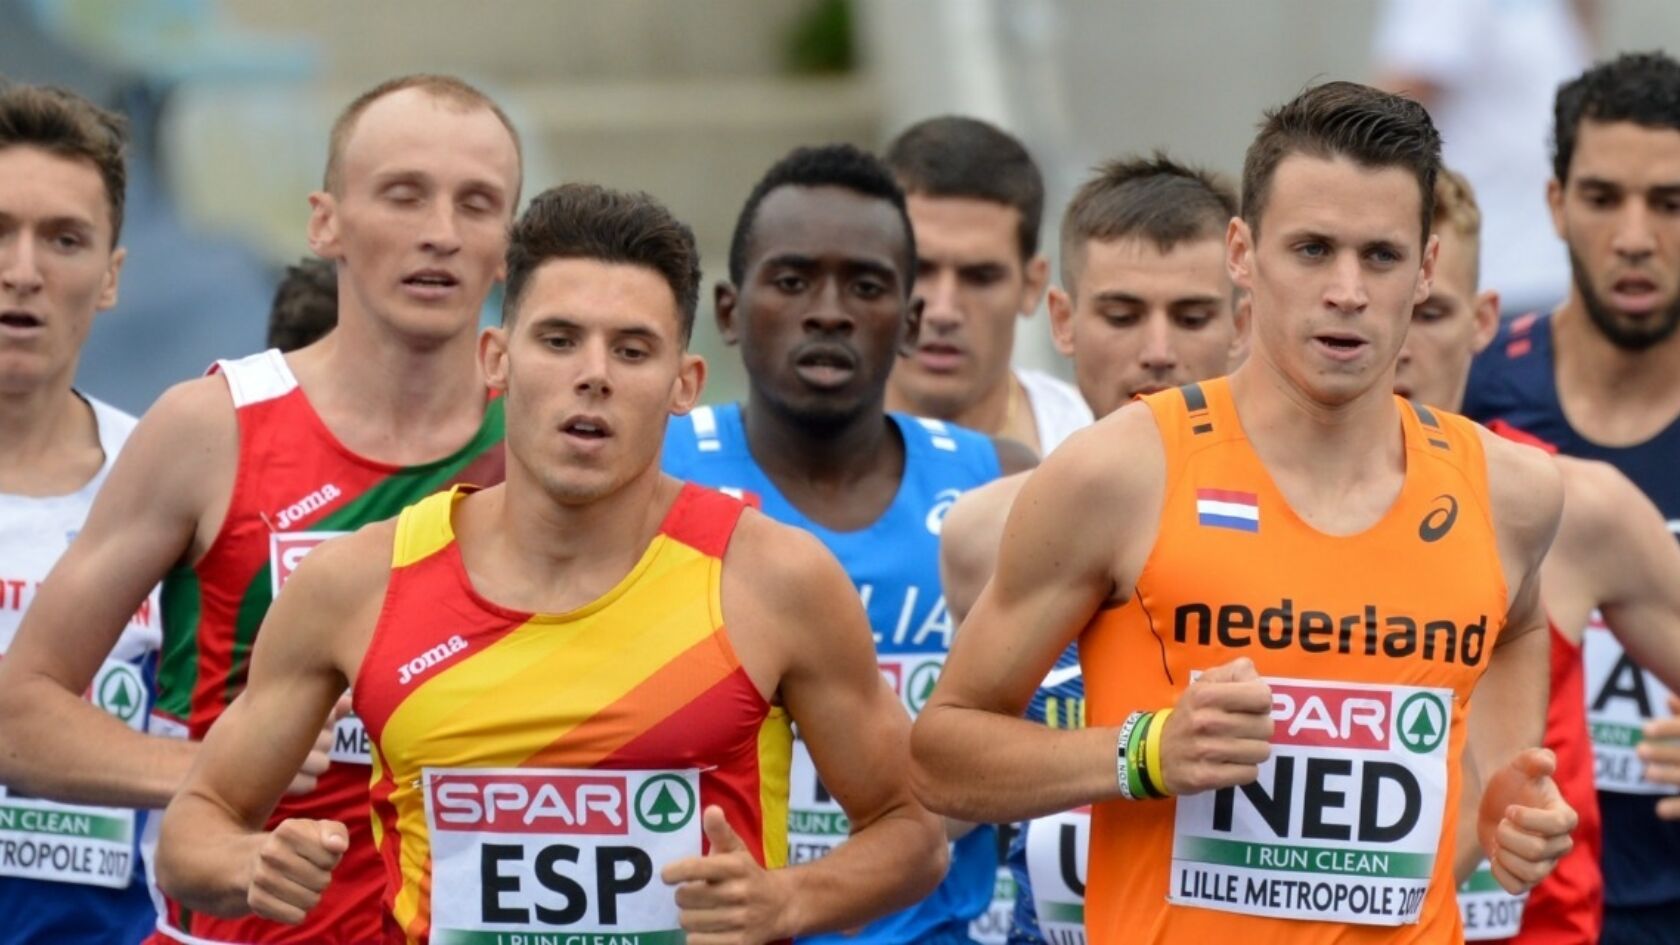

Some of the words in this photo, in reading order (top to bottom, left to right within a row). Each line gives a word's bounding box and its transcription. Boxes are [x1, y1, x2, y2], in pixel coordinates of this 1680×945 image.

[1174, 598, 1487, 667] nederland
[1590, 650, 1653, 718] A
[20, 810, 92, 835] CLEAN
[436, 782, 623, 827] SPAR
[1212, 755, 1423, 844] NED
[481, 842, 653, 926] ESP
[1245, 845, 1252, 865] I
[1259, 847, 1309, 868] RUN
[1315, 850, 1390, 873] CLEAN
[1180, 868, 1239, 901] LILLE
[1243, 877, 1393, 915] METROPOLE
